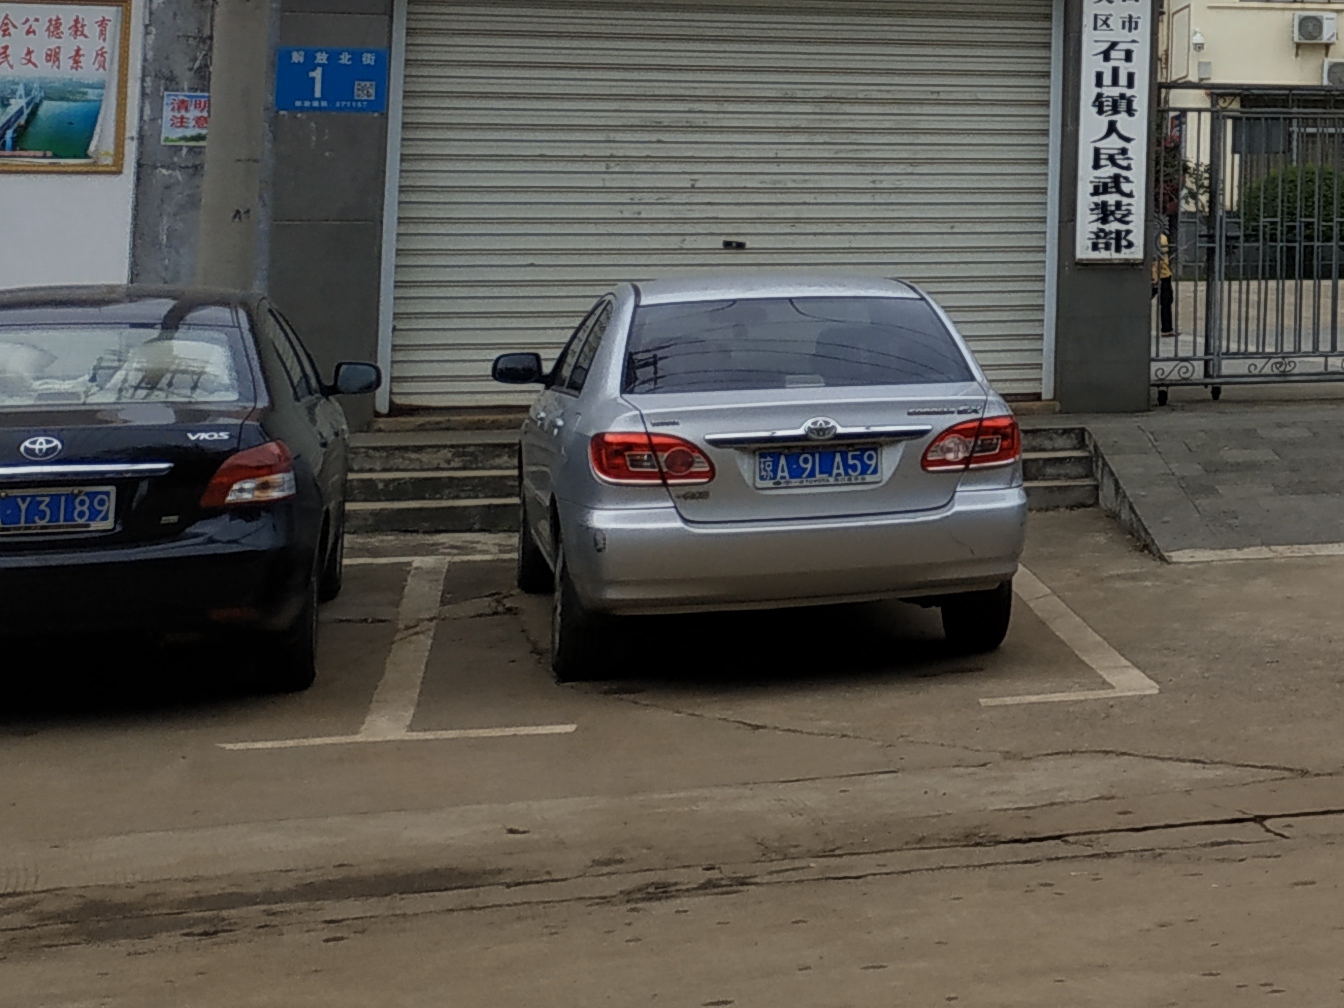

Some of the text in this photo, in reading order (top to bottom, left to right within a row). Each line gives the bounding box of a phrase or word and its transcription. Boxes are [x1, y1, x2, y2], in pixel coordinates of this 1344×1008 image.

[0, 13, 113, 43] 会公德教育
[0, 45, 109, 73] 民文明素质
[290, 50, 376, 65] 解放北街
[308, 66, 323, 99] 1
[169, 115, 208, 130] 注意
[1087, 39, 1139, 254] 石山镇人民武装部
[187, 432, 230, 441] VIOS
